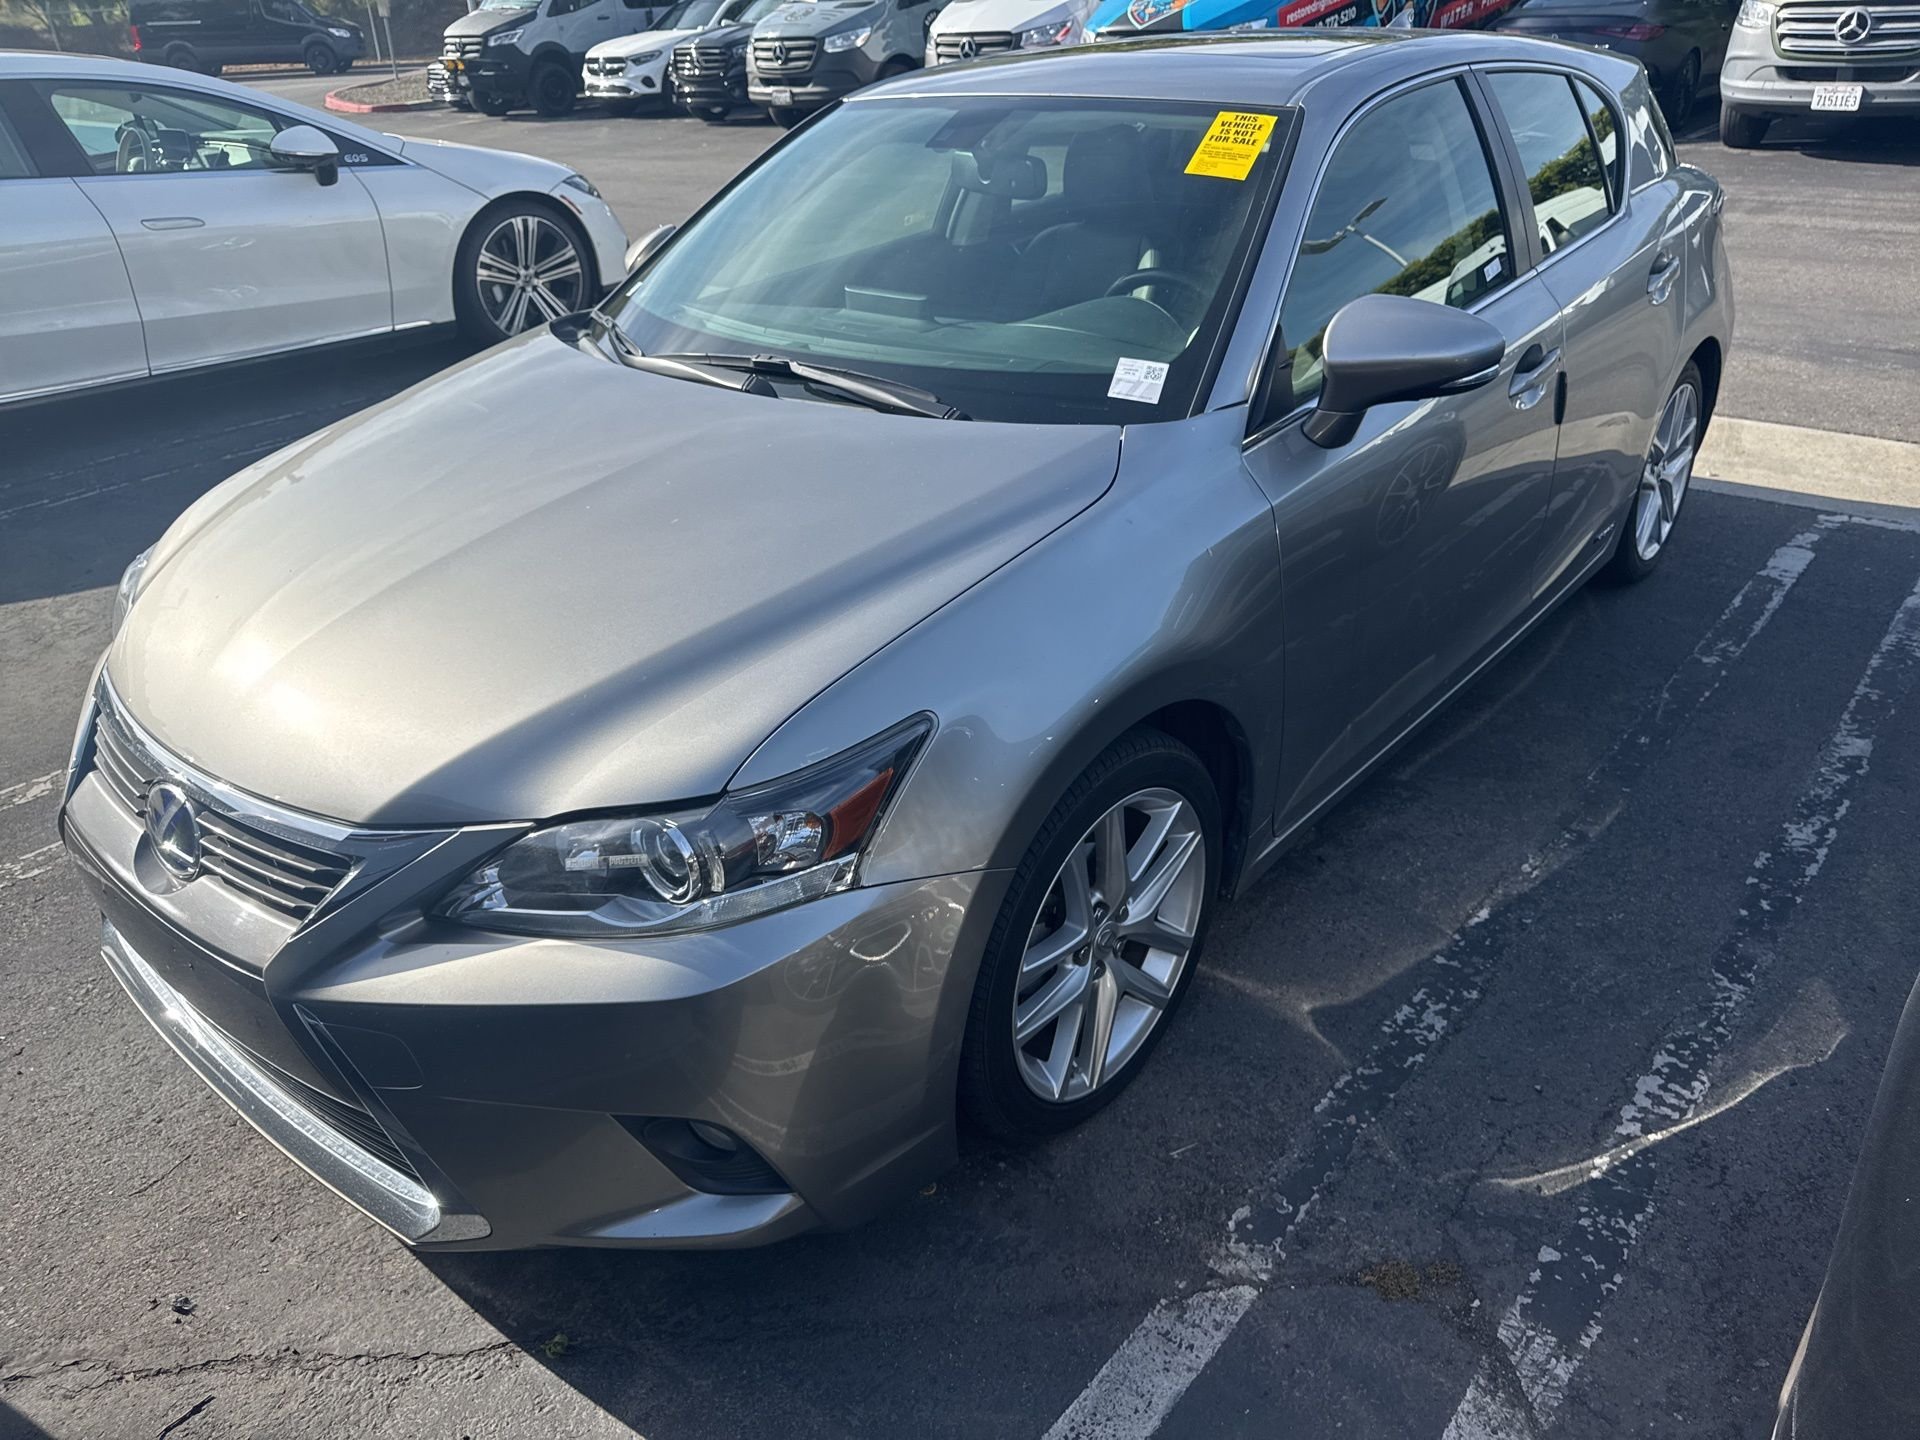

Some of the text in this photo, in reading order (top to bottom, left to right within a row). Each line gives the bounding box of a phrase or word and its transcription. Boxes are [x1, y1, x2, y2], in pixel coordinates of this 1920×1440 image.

[1440, 1, 1474, 29] WATER
[1816, 94, 1858, 107] 71511E3
[1233, 114, 1259, 123] THIS
[1220, 120, 1264, 131] VEHICLE
[1232, 129, 1257, 138] NOT
[1208, 135, 1259, 146] FOR SALE
